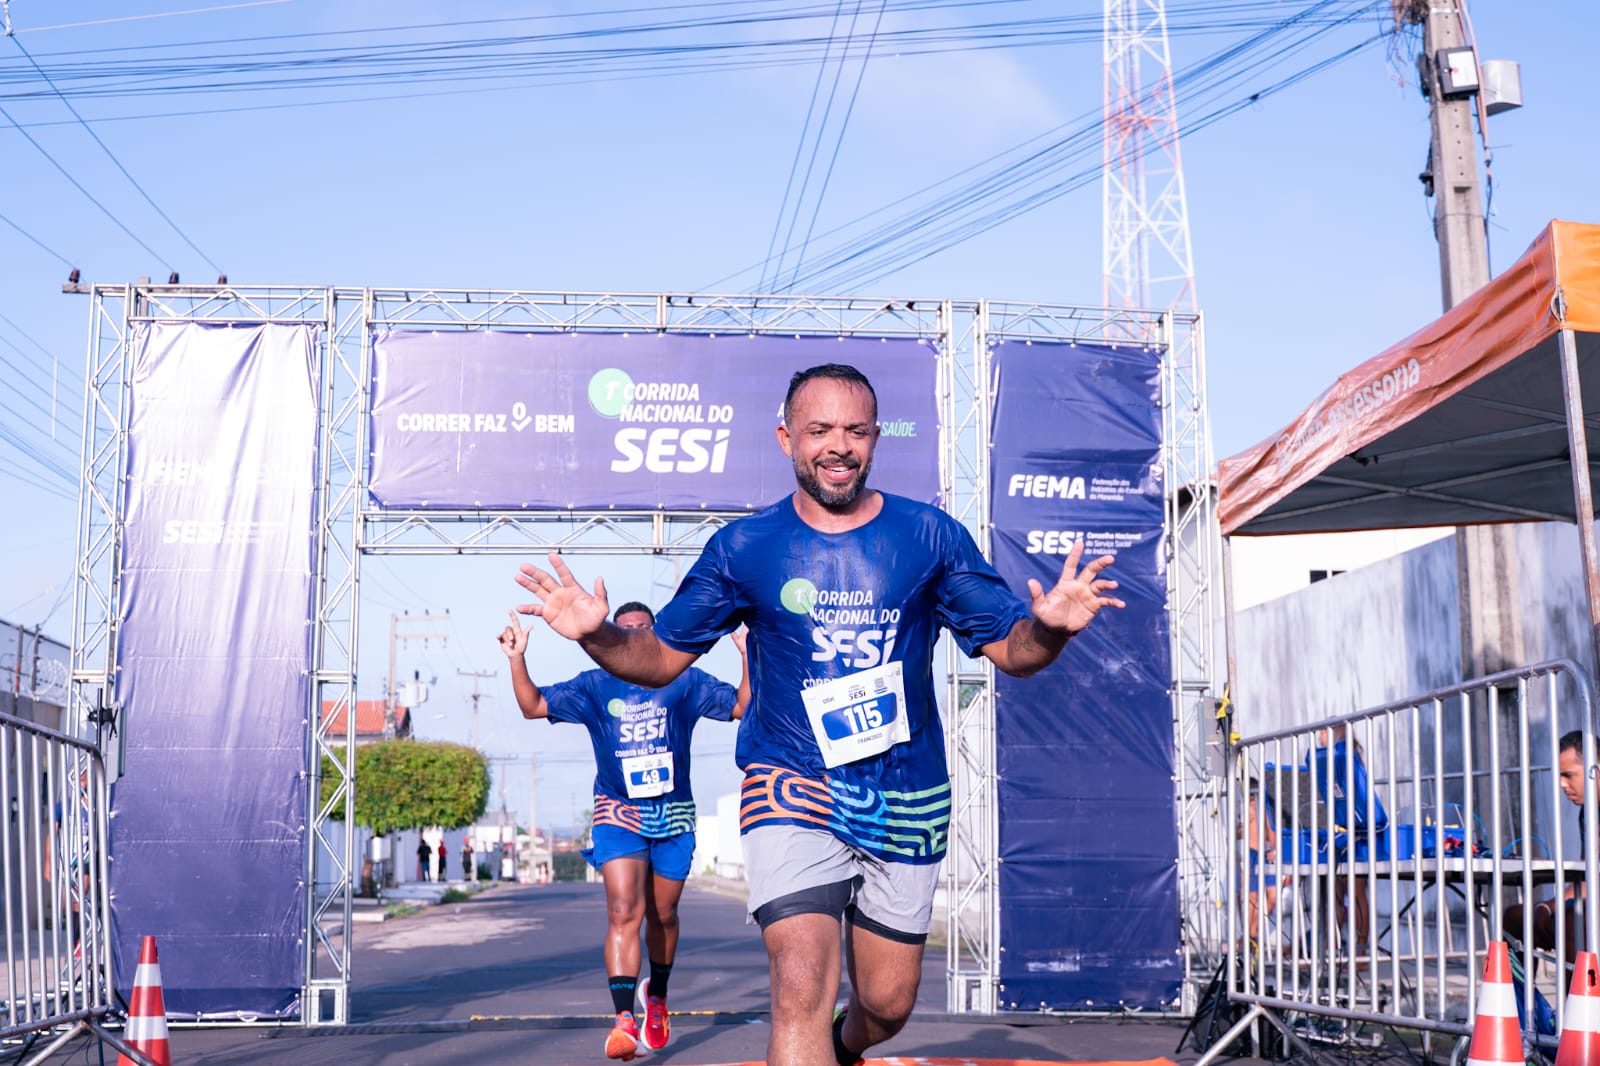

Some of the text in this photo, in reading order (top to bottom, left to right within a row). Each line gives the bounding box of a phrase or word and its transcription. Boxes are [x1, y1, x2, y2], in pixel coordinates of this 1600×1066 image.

[623, 382, 700, 401] CORRIDA
[620, 404, 734, 423] NACIONAL DO
[397, 414, 471, 433] CORRER
[474, 414, 507, 433] FAZ
[535, 414, 575, 433] BEM
[881, 419, 917, 437] SAÚDE.
[809, 590, 873, 606] CORRIDA
[809, 606, 900, 624] NACIONAL DO
[620, 707, 668, 722] NACIONAL DO
[843, 700, 883, 735] 115
[642, 769, 660, 785] 49
